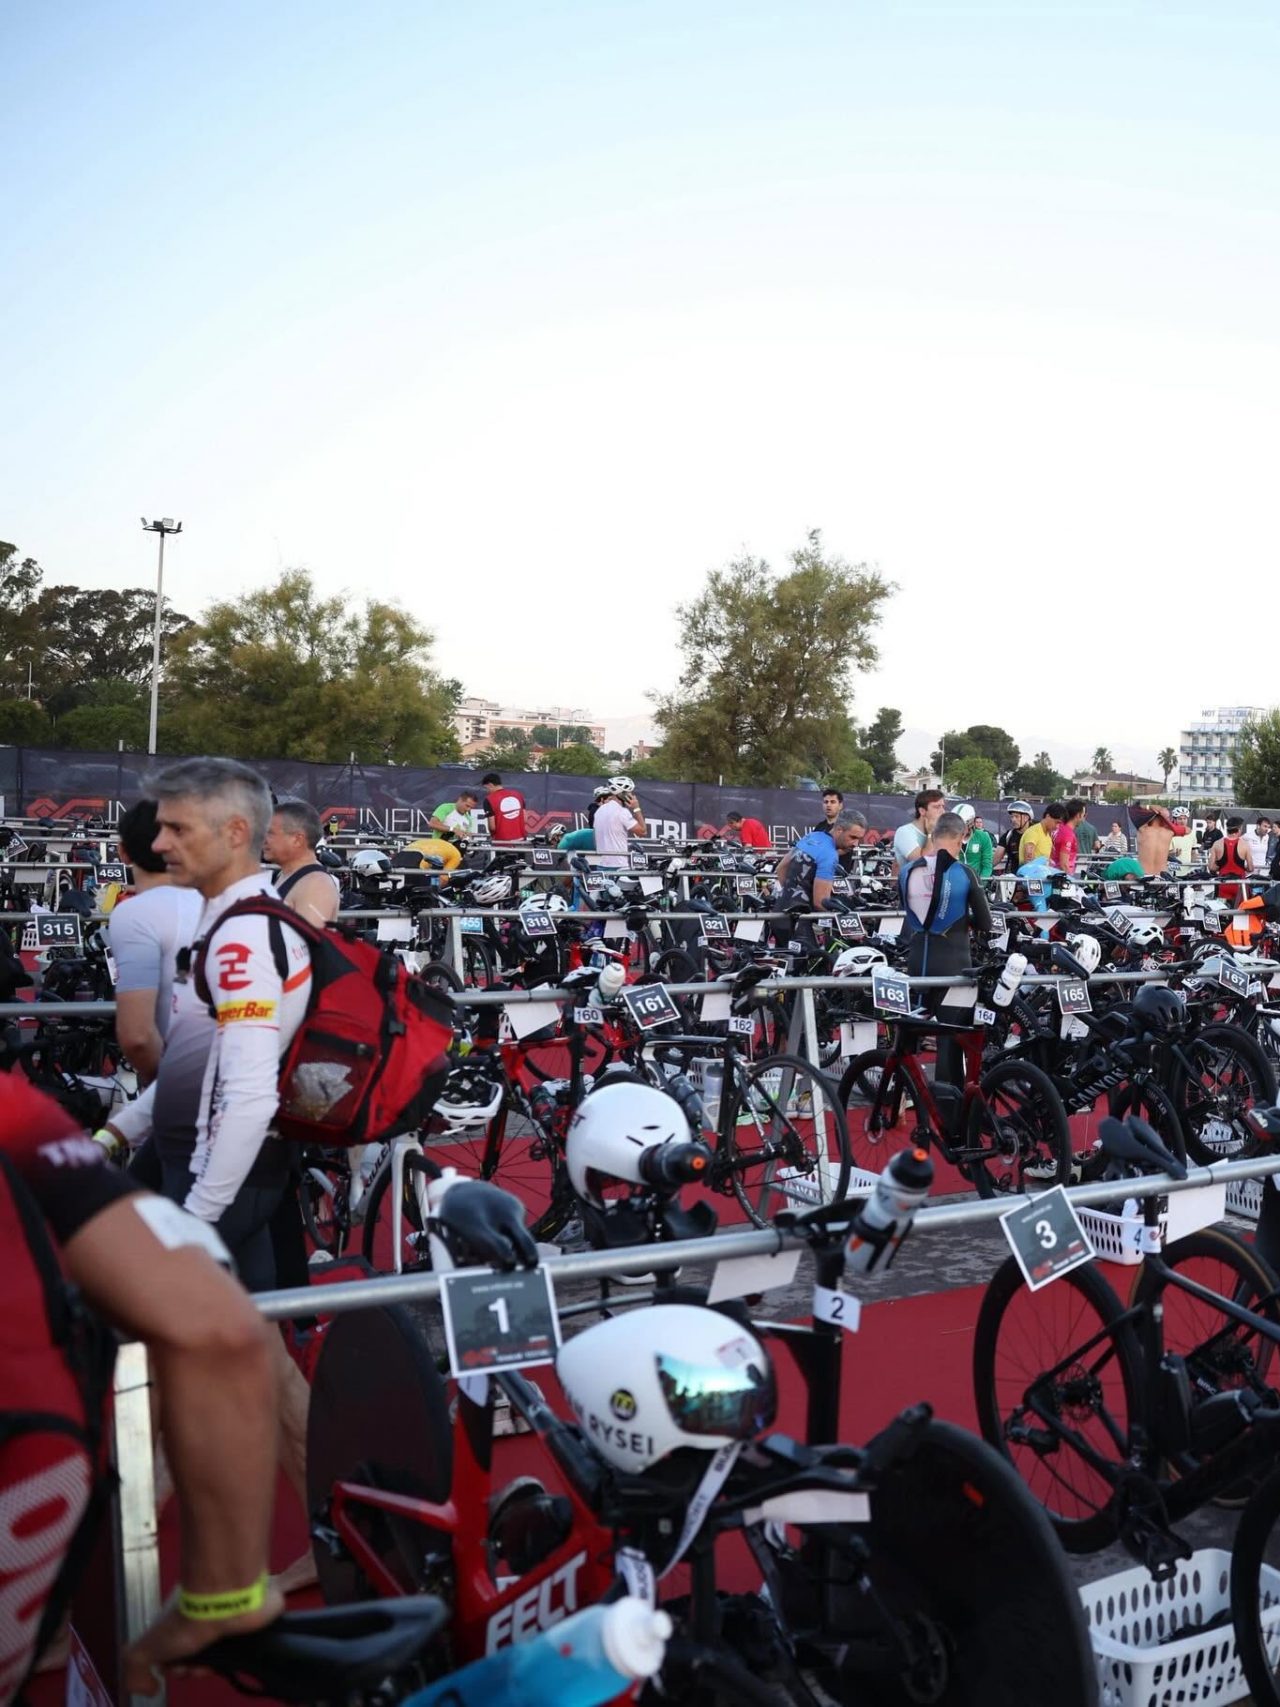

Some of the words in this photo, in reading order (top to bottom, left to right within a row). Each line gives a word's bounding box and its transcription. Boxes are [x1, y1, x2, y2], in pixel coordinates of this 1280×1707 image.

[99, 868, 122, 878] 453
[739, 880, 754, 889] 457
[42, 923, 75, 936] 315
[526, 917, 550, 928] 319
[704, 919, 724, 931] 321
[840, 918, 859, 929] 323
[992, 917, 1004, 927] 25
[1224, 969, 1245, 987] 167
[878, 986, 905, 1003] 163
[1061, 986, 1086, 1003] 165
[635, 995, 666, 1015] 161
[977, 1009, 994, 1023] 164
[733, 1018, 753, 1032] 162
[1068, 1067, 1130, 1109] CANYON
[1035, 1219, 1058, 1249] 3
[1133, 1227, 1143, 1246] 4
[488, 1297, 510, 1333] 1
[830, 1296, 844, 1320] 2
[485, 1549, 588, 1659] FELT
